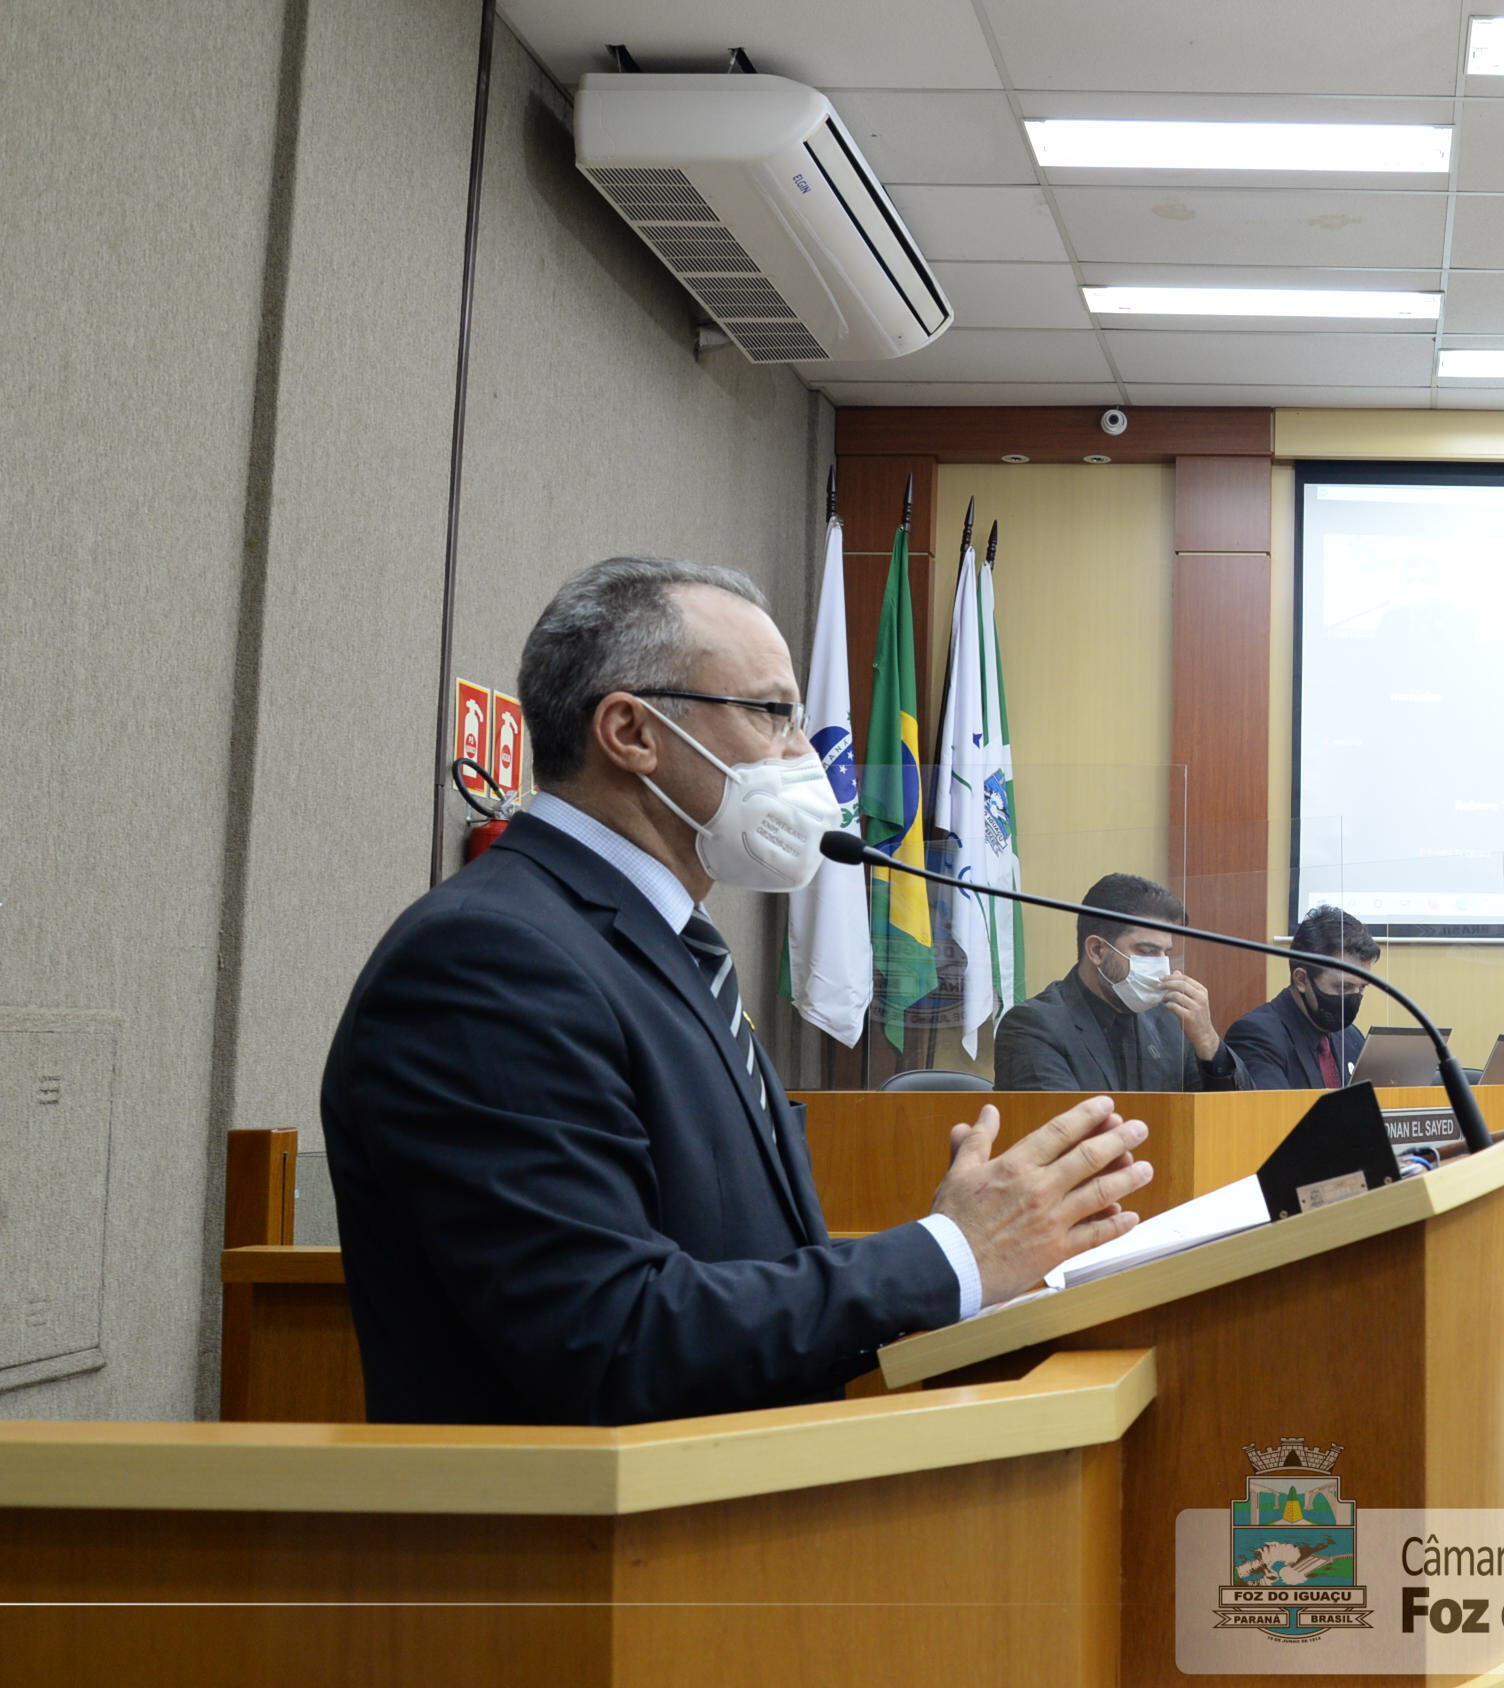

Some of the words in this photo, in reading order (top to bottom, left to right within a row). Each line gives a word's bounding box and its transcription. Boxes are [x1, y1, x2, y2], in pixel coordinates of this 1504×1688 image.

[793, 173, 812, 194] ELGIN
[1384, 1121, 1410, 1139] DNAN
[1412, 1120, 1424, 1137] EL
[1425, 1119, 1454, 1136] SAYED
